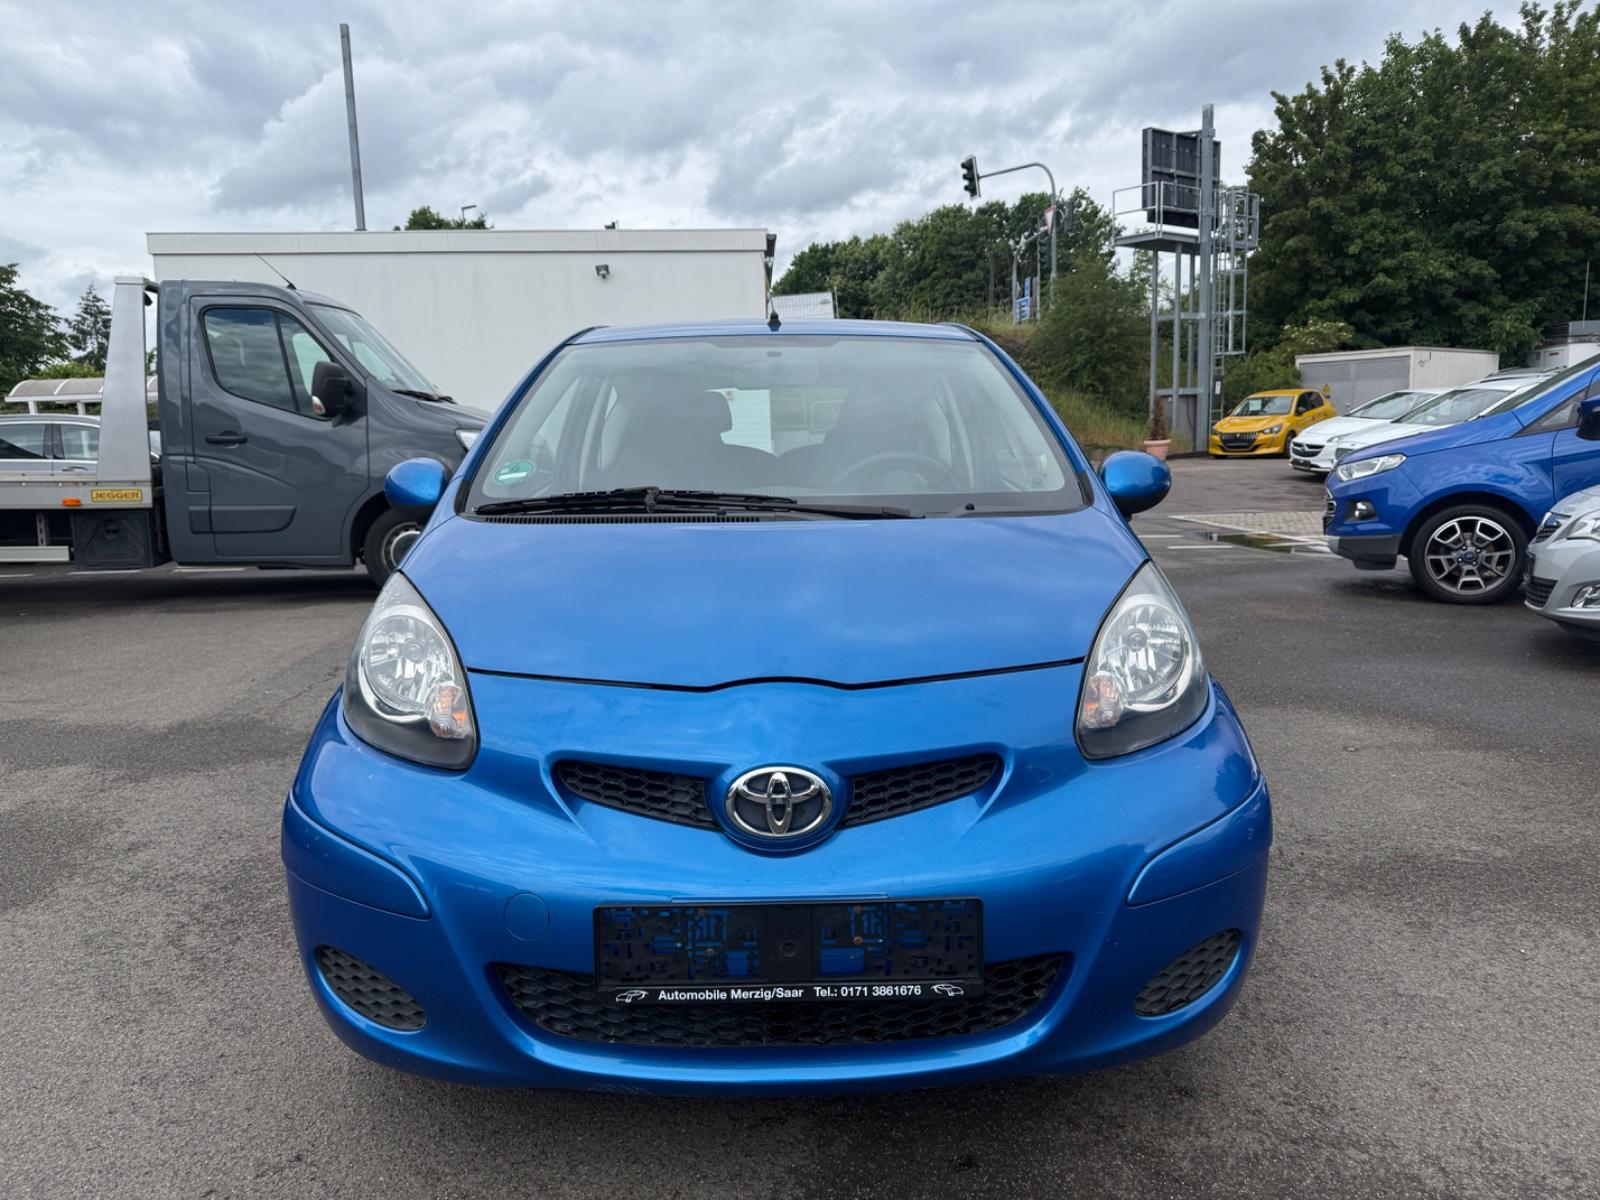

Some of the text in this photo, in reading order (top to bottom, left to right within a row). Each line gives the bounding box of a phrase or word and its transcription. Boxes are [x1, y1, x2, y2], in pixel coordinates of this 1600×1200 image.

[94, 491, 140, 500] JEGGER
[658, 985, 922, 1001] Automobile Merzig/Saar Tel.: 0171 3861676
